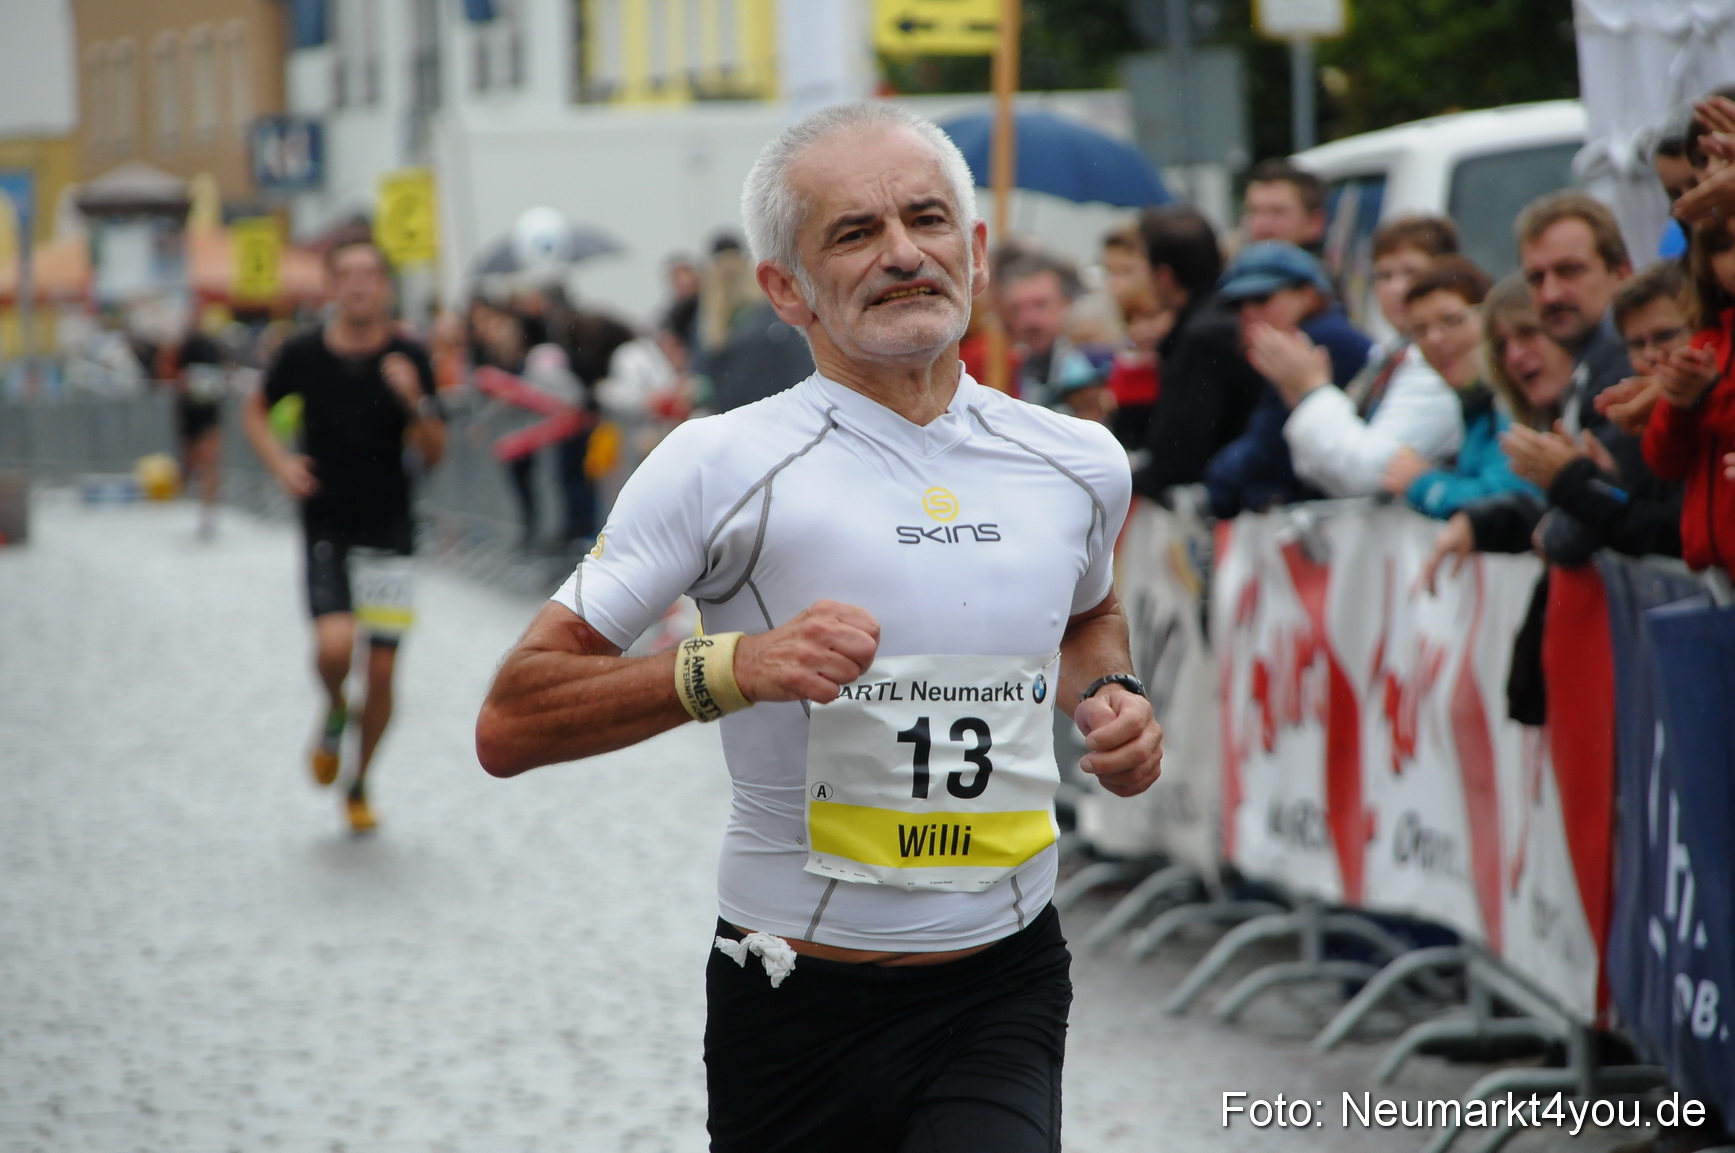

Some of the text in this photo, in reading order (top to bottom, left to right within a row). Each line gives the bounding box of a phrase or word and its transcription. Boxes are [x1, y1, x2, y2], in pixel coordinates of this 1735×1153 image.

[836, 682, 904, 701] ARTL
[910, 681, 1024, 702] Neumarkt
[896, 716, 993, 799] 13
[816, 784, 827, 798] A
[897, 823, 972, 858] Willi
